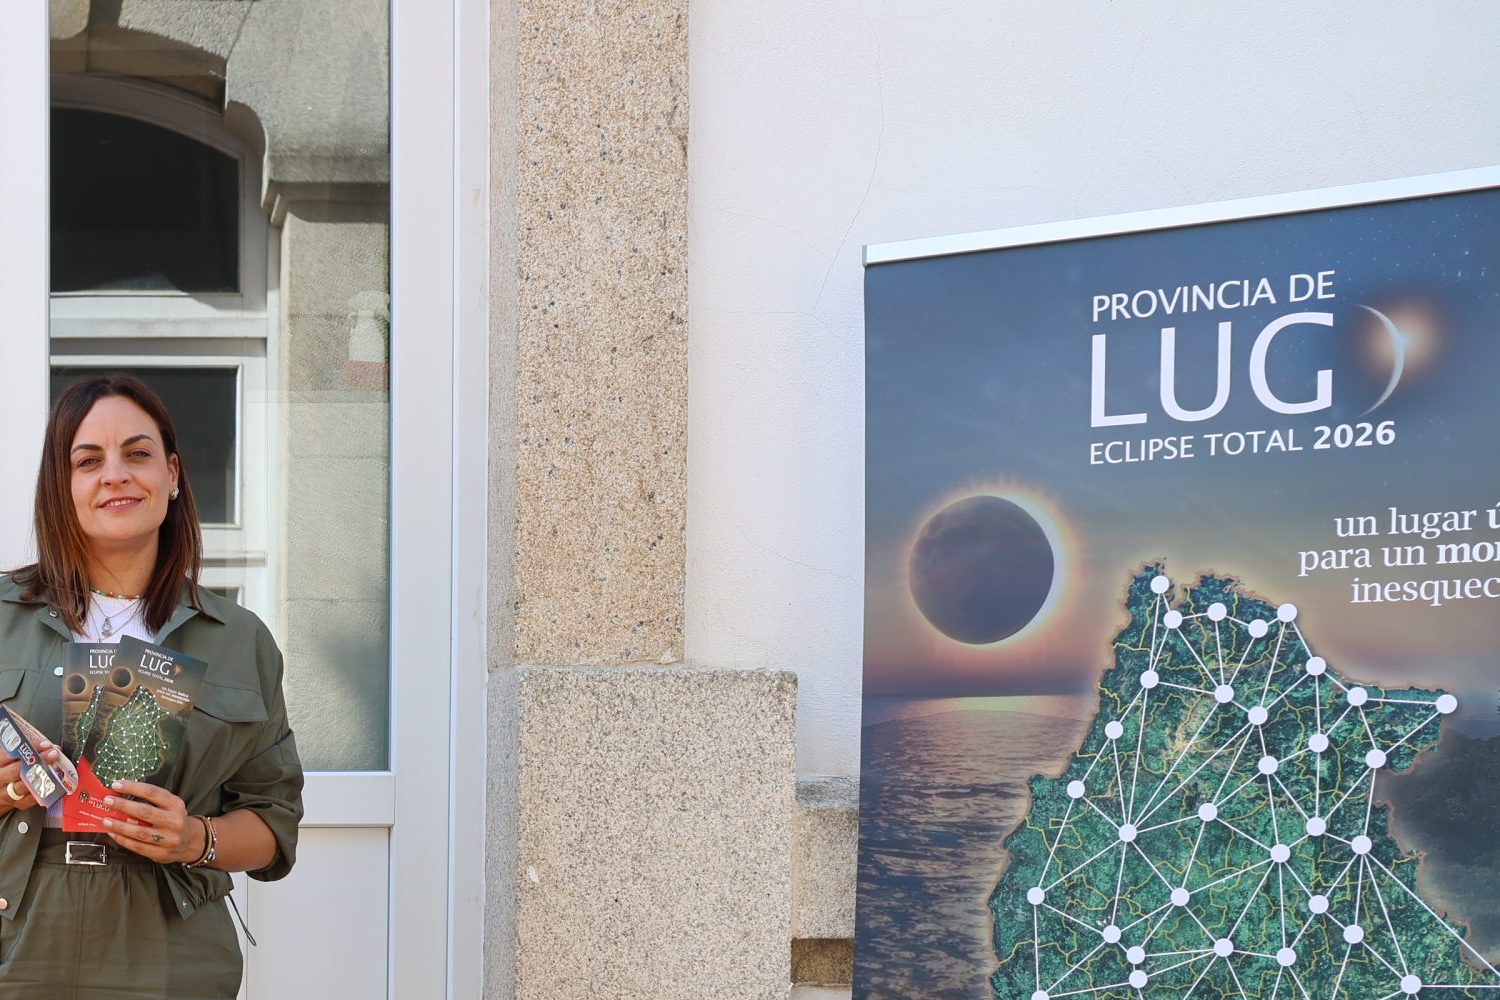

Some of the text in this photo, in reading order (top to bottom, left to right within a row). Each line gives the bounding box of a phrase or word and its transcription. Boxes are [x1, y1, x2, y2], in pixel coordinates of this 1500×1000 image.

[1093, 270, 1335, 322] PROVINCIA DE
[1090, 420, 1395, 465] ECLIPSE TOTAL 2026
[1334, 515, 1379, 537] un
[1388, 507, 1476, 539] lugar
[1298, 546, 1372, 577] para
[1381, 544, 1427, 567] un
[1350, 576, 1500, 607] inesquec
